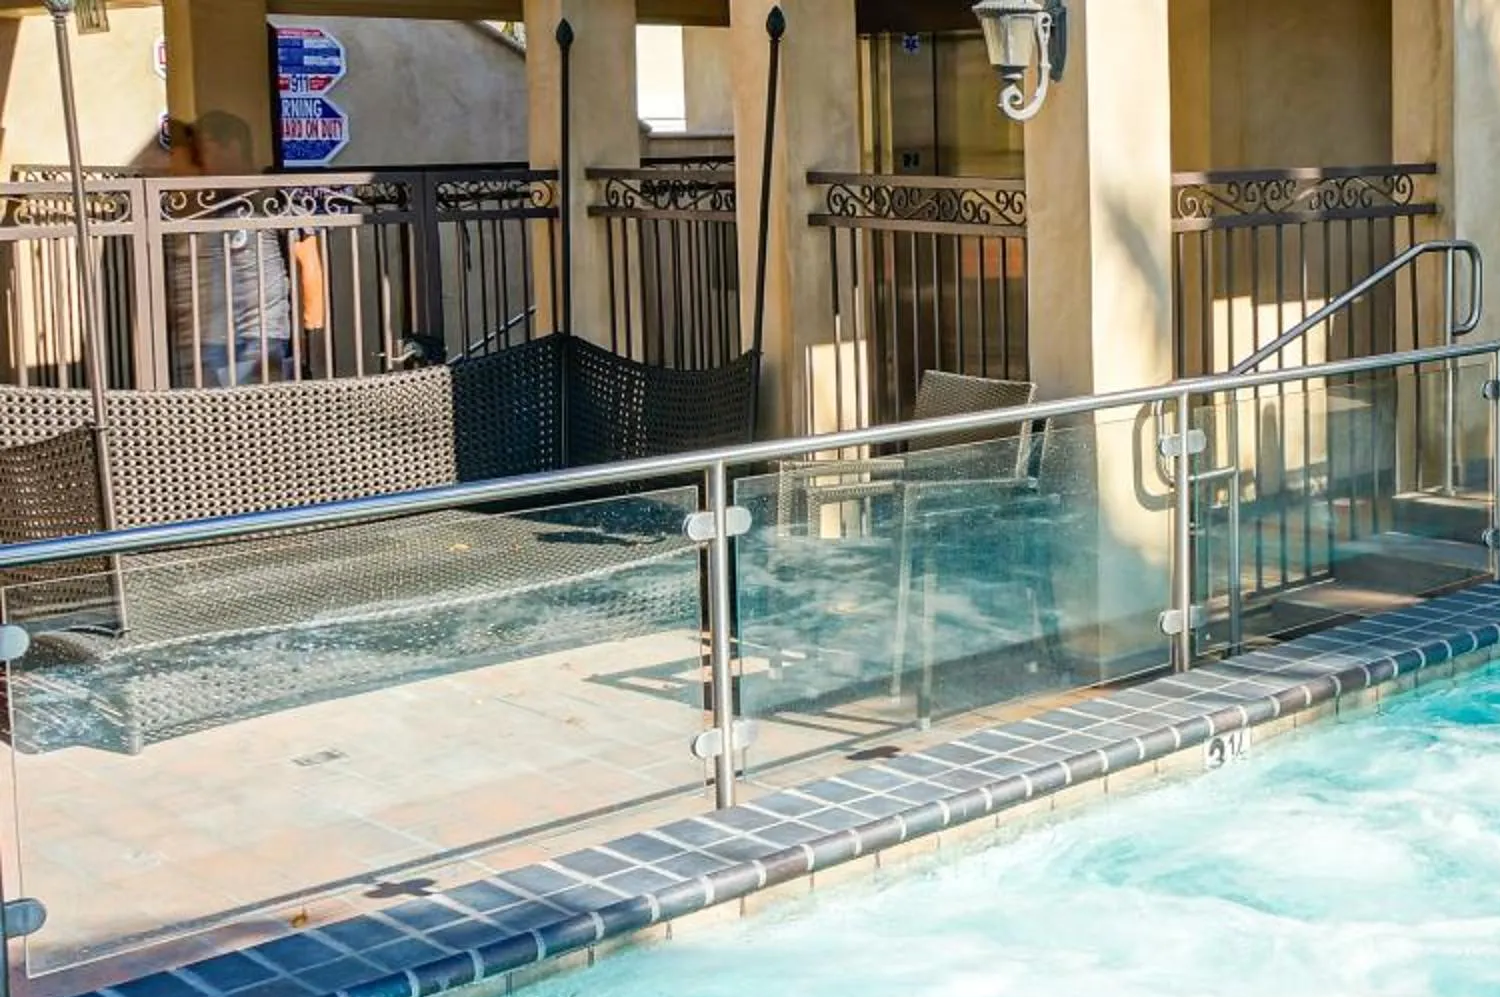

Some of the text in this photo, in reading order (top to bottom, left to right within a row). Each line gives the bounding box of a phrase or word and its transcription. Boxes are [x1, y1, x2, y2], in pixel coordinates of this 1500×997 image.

[291, 75, 309, 92] 911
[306, 120, 319, 138] ON
[321, 120, 343, 138] DUTY
